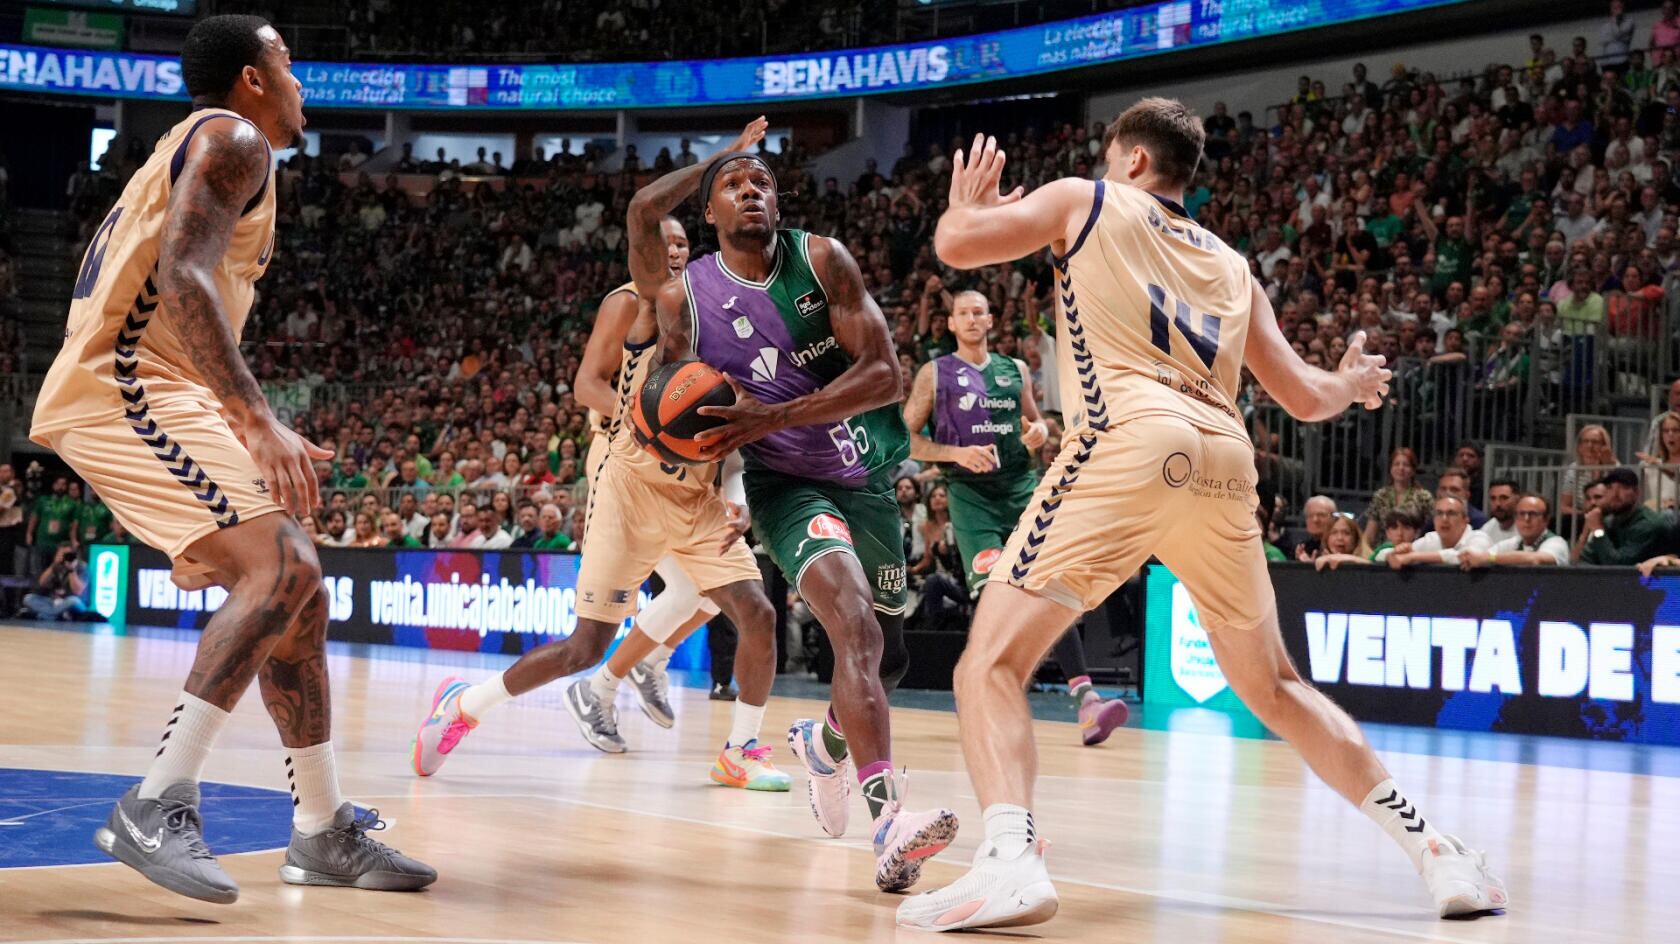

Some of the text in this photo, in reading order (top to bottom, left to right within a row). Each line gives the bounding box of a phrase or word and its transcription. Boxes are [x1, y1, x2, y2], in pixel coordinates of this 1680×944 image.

[306, 67, 328, 82] La
[499, 69, 525, 85] The
[497, 87, 617, 103] natural choice
[1147, 282, 1221, 372] 14
[789, 336, 839, 367] Unica
[979, 398, 1016, 411] Unicaja
[972, 420, 1013, 434] málaga
[828, 416, 870, 467] 55
[1191, 470, 1222, 489] Costa
[1304, 612, 1522, 695] VENTA
[1539, 621, 1635, 701] DE
